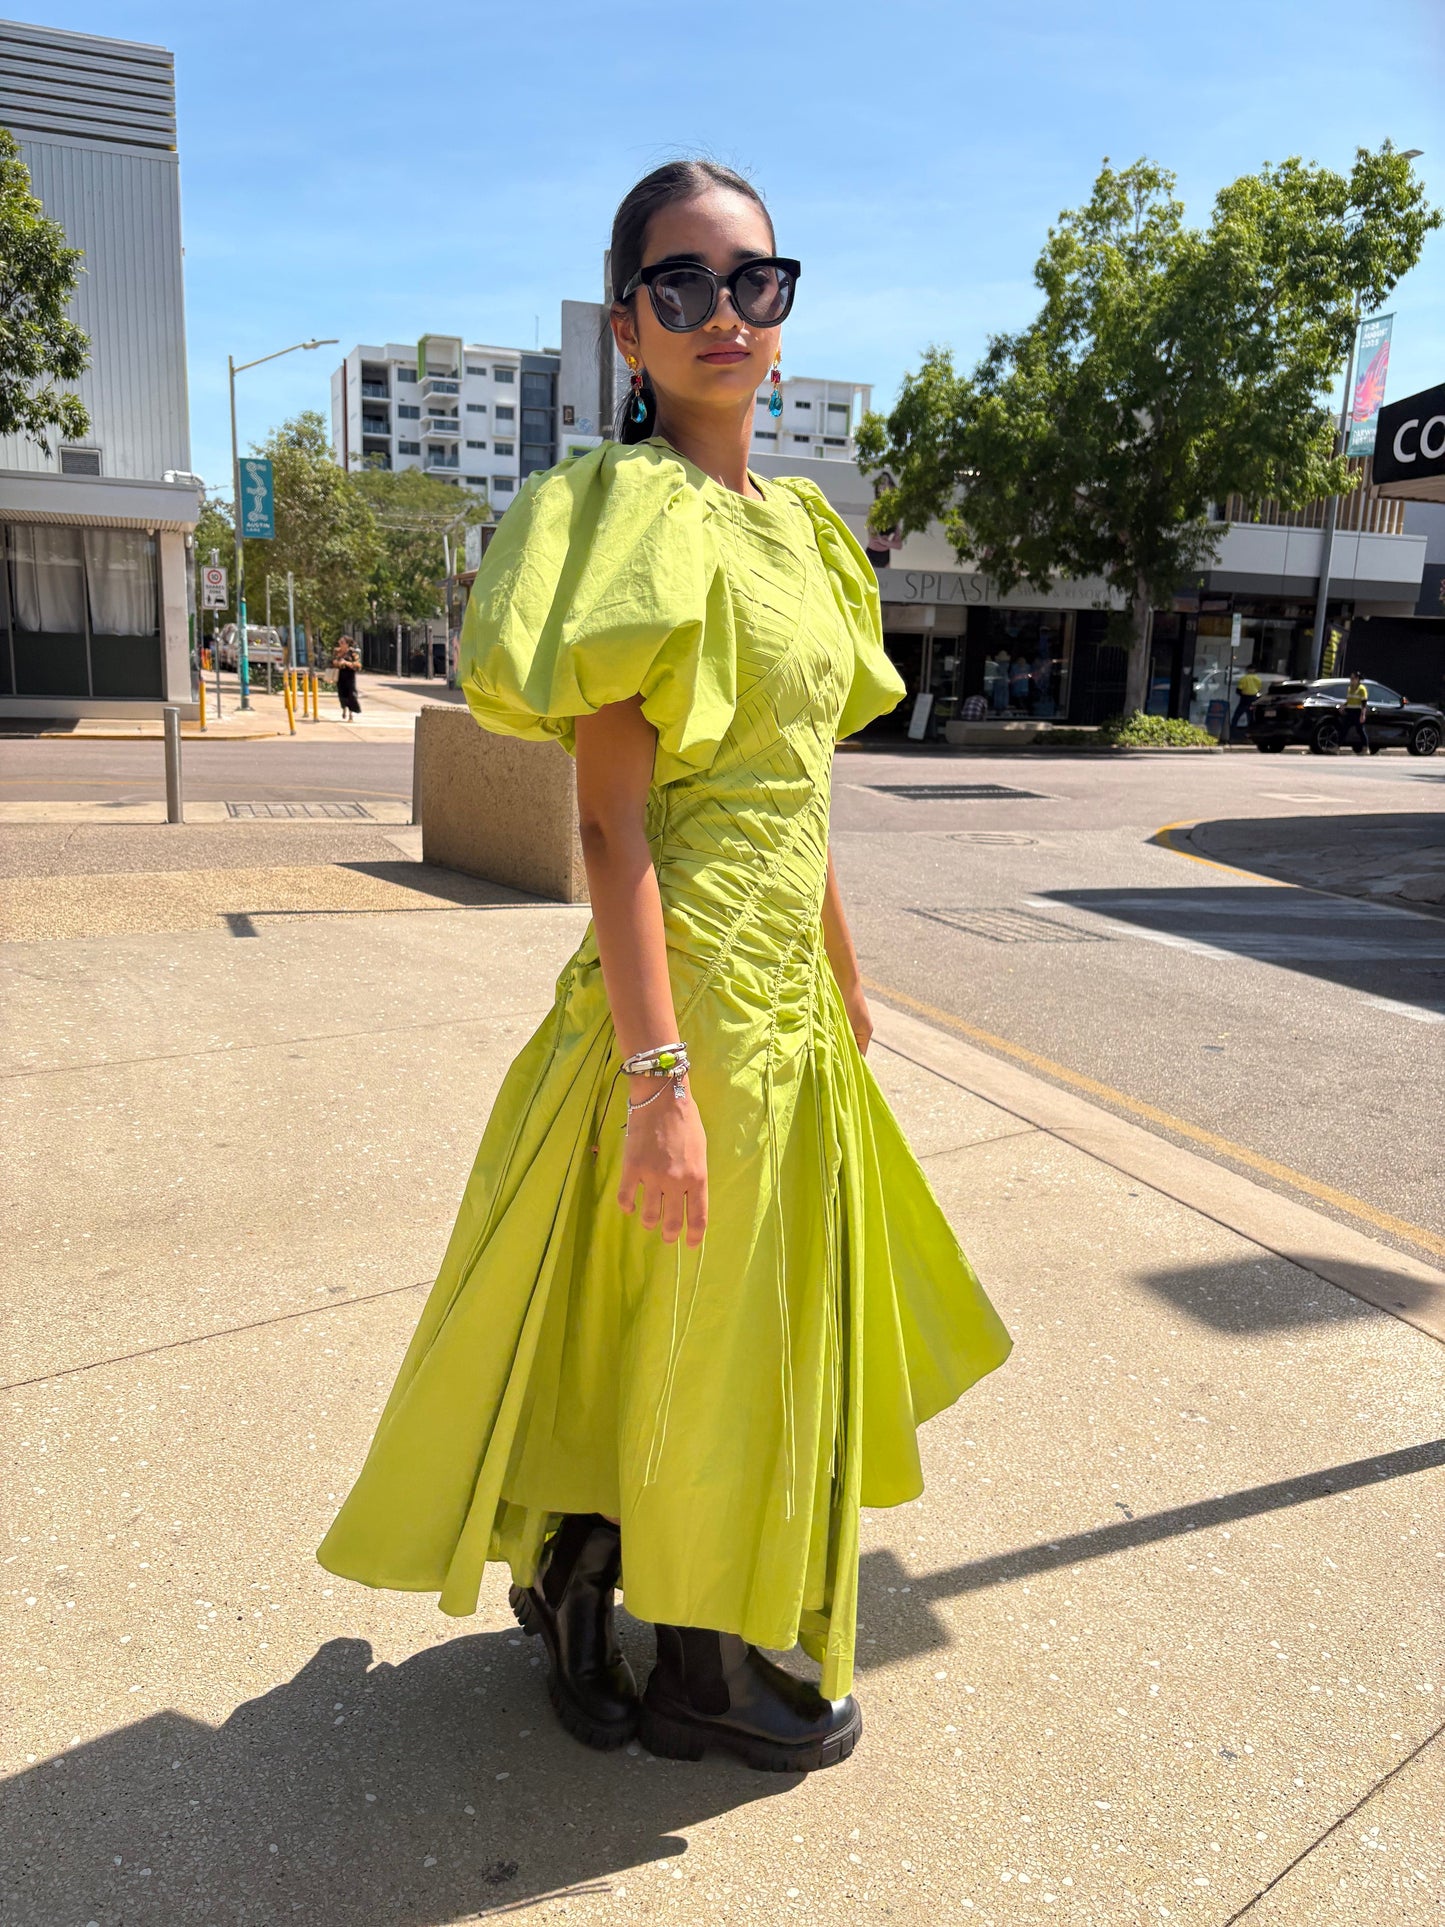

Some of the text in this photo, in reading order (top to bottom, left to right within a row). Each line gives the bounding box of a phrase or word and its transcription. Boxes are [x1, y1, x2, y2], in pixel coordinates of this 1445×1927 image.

[1363, 327, 1388, 340] AUGUST
[246, 521, 271, 529] AUSTIN
[211, 573, 219, 581] 10
[903, 572, 1001, 602] SPLASH
